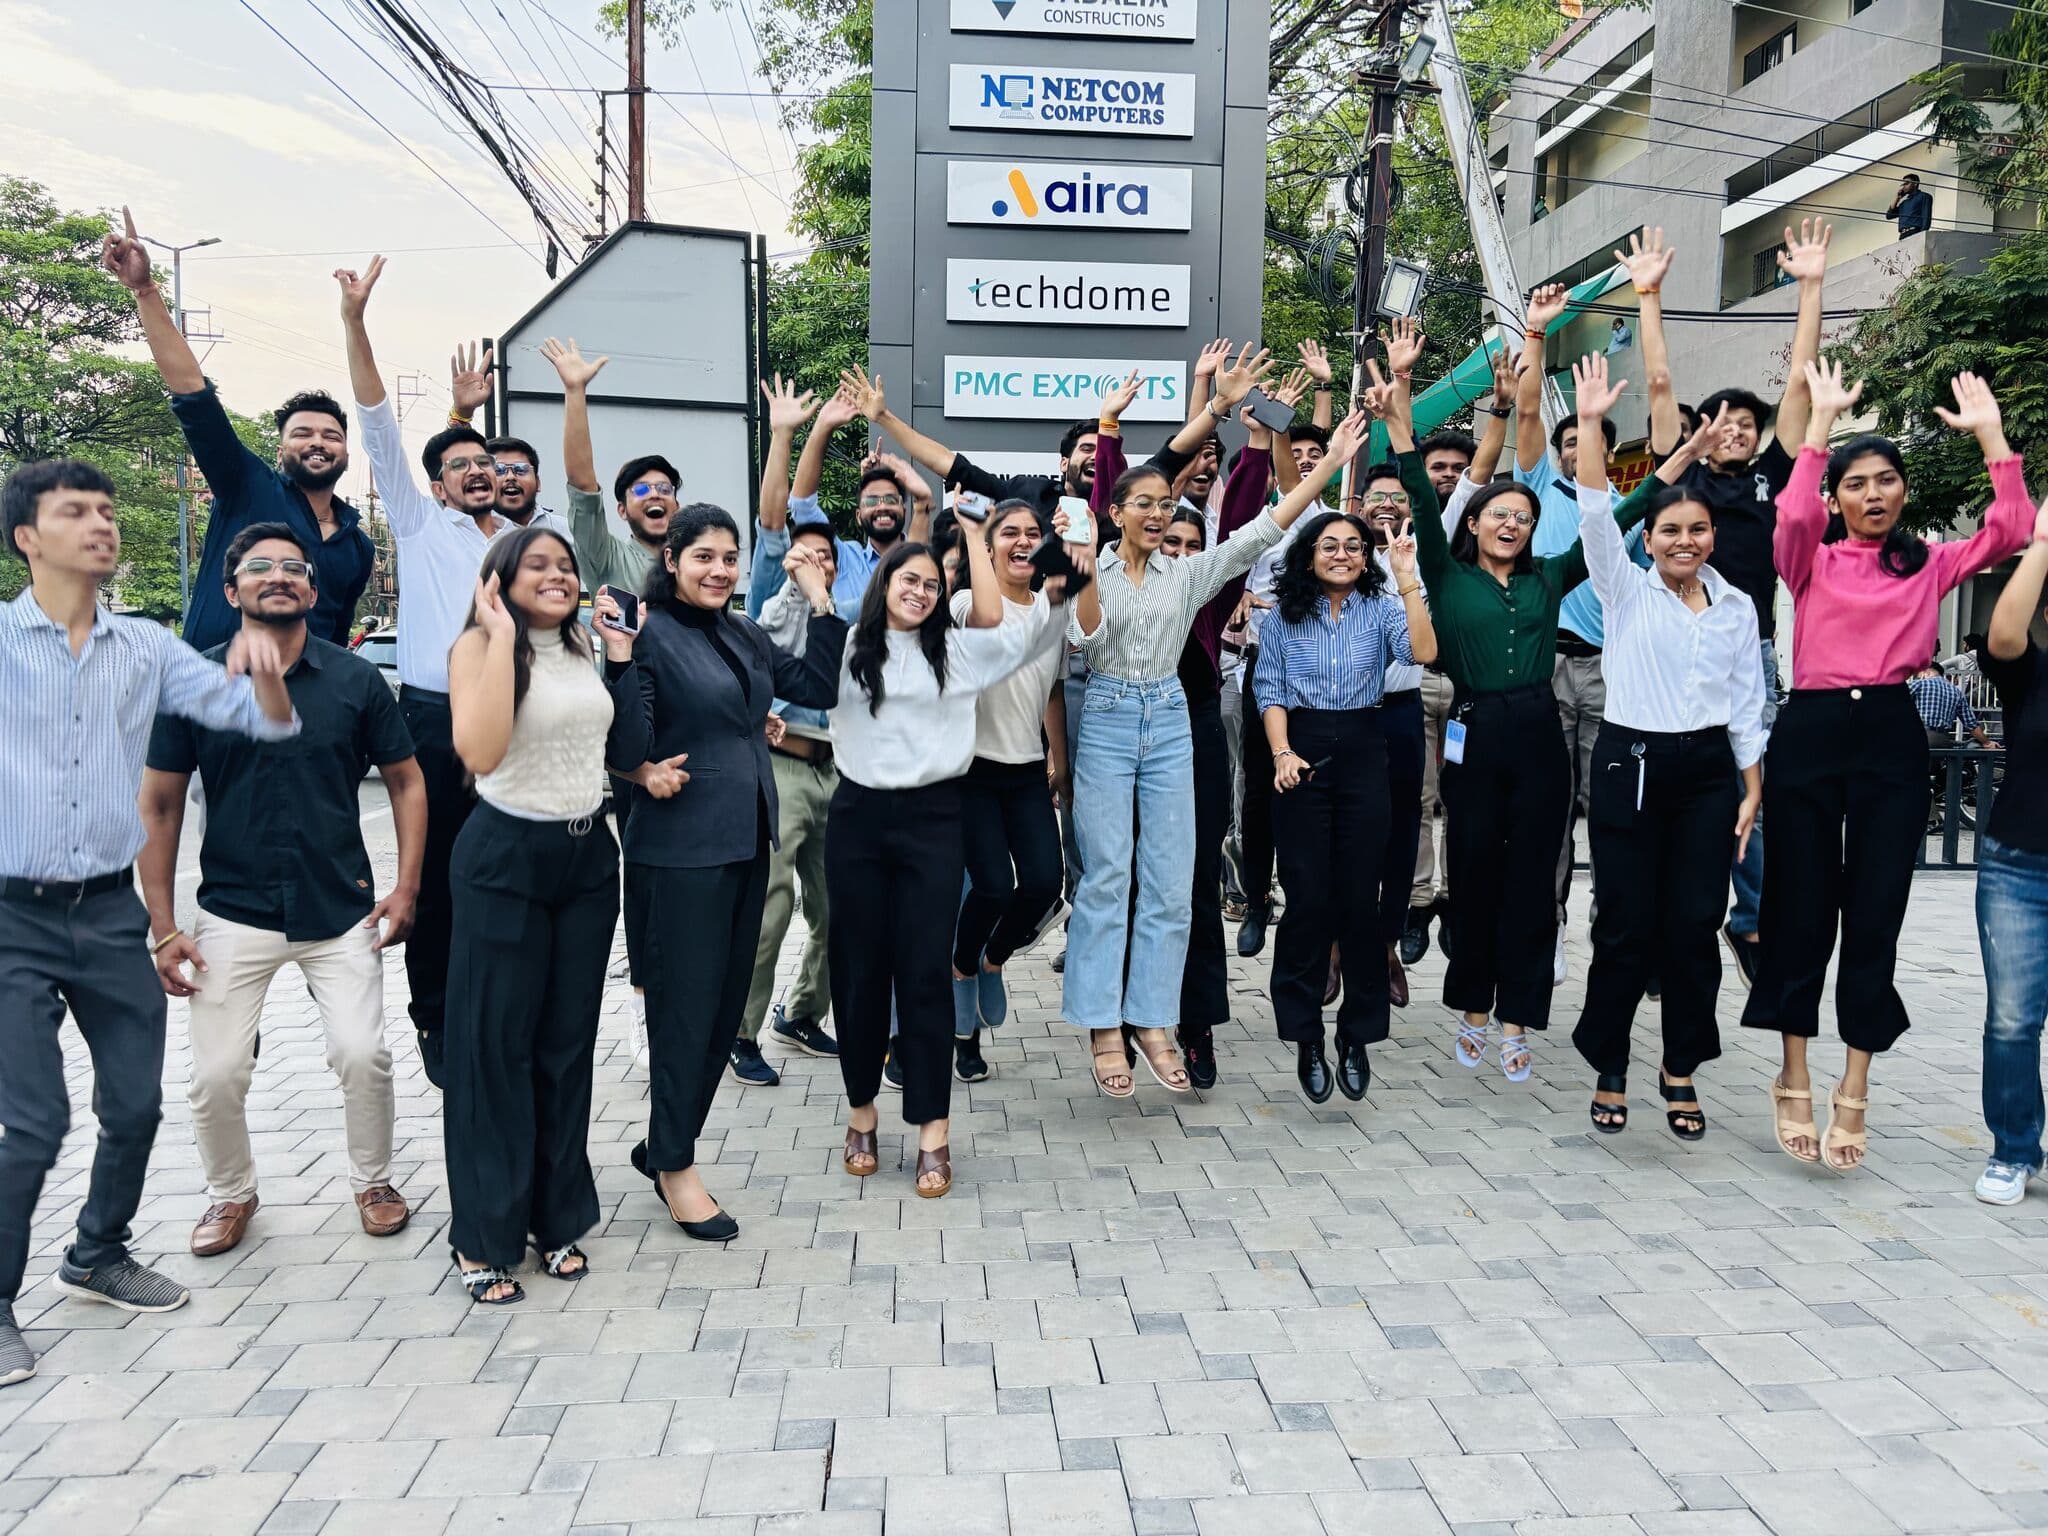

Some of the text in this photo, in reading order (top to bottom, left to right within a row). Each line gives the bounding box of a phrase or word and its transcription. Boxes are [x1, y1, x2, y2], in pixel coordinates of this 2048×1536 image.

[1044, 9, 1165, 28] CONSTRUCTIONS
[1042, 77, 1165, 106] NETCOM
[1041, 104, 1165, 125] COMPUTERS
[1044, 172, 1148, 215] aira
[967, 274, 1170, 312] techdome
[955, 371, 1022, 397] PMC
